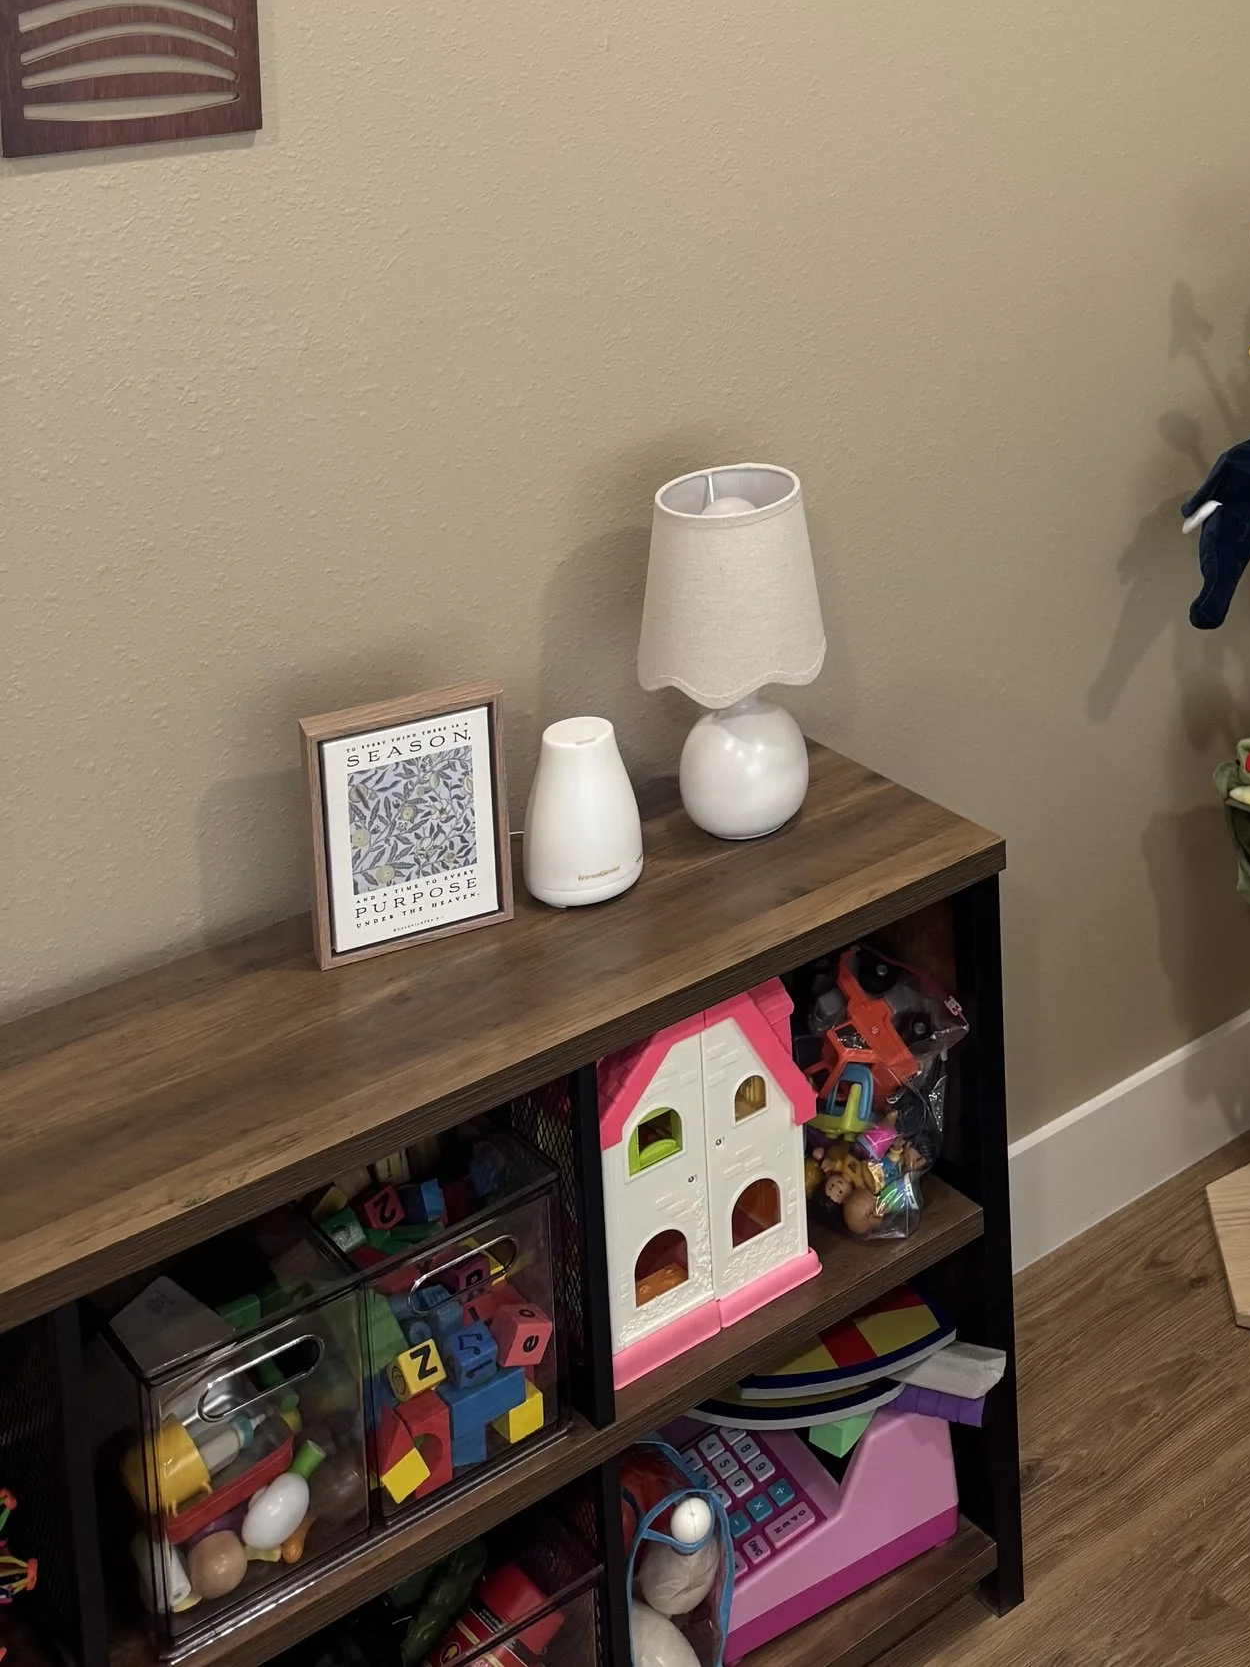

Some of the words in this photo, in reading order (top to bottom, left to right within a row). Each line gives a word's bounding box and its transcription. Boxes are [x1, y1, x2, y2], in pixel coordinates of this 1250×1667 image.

[346, 729, 471, 768] SEASON,
[361, 740, 386, 750] EVERY
[391, 733, 417, 743] THING
[356, 895, 376, 904] AND
[394, 884, 419, 894] TIME
[425, 878, 437, 886] TO
[444, 868, 475, 881] EVERY
[355, 877, 477, 919] PURPOSE
[356, 913, 394, 929] UNDER
[401, 906, 424, 916] THE
[705, 1441, 717, 1452] 4
[740, 1442, 752, 1453] 8
[718, 1458, 730, 1469] 5
[755, 1461, 767, 1472] 9
[734, 1476, 745, 1488] 6
[774, 1509, 806, 1535] OPEN
